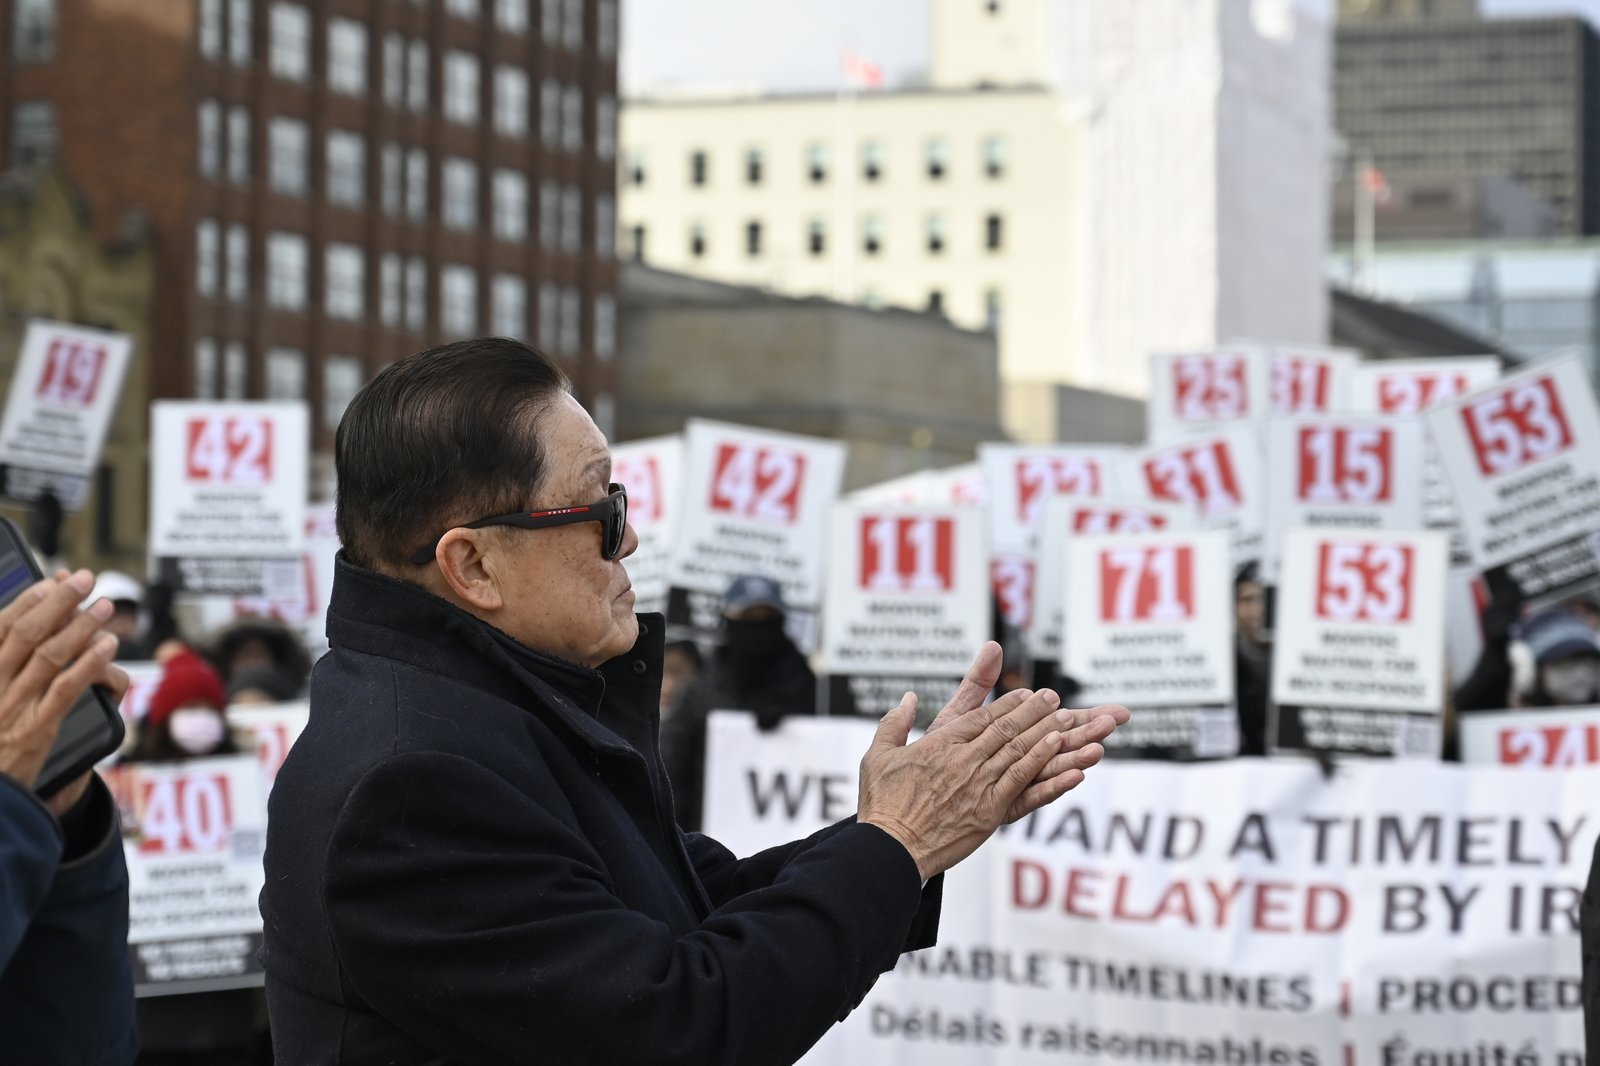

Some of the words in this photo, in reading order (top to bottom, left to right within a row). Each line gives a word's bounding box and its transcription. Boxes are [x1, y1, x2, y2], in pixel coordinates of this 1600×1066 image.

[187, 416, 271, 482] 42
[1467, 378, 1569, 477] 53
[711, 444, 801, 522] 42
[1303, 430, 1386, 501] 15
[866, 516, 947, 591] 11
[1106, 546, 1190, 621] 71
[1322, 544, 1407, 620] 53
[141, 774, 229, 852] 40
[747, 769, 849, 821] WE
[1000, 804, 1207, 862] AND
[1229, 811, 1277, 862] A
[1304, 813, 1586, 866] TIMELY
[1012, 859, 1352, 935] DELAYED
[1382, 883, 1480, 935] BY
[1063, 953, 1314, 1013] TIMELINES
[871, 1001, 1006, 1045] Délais
